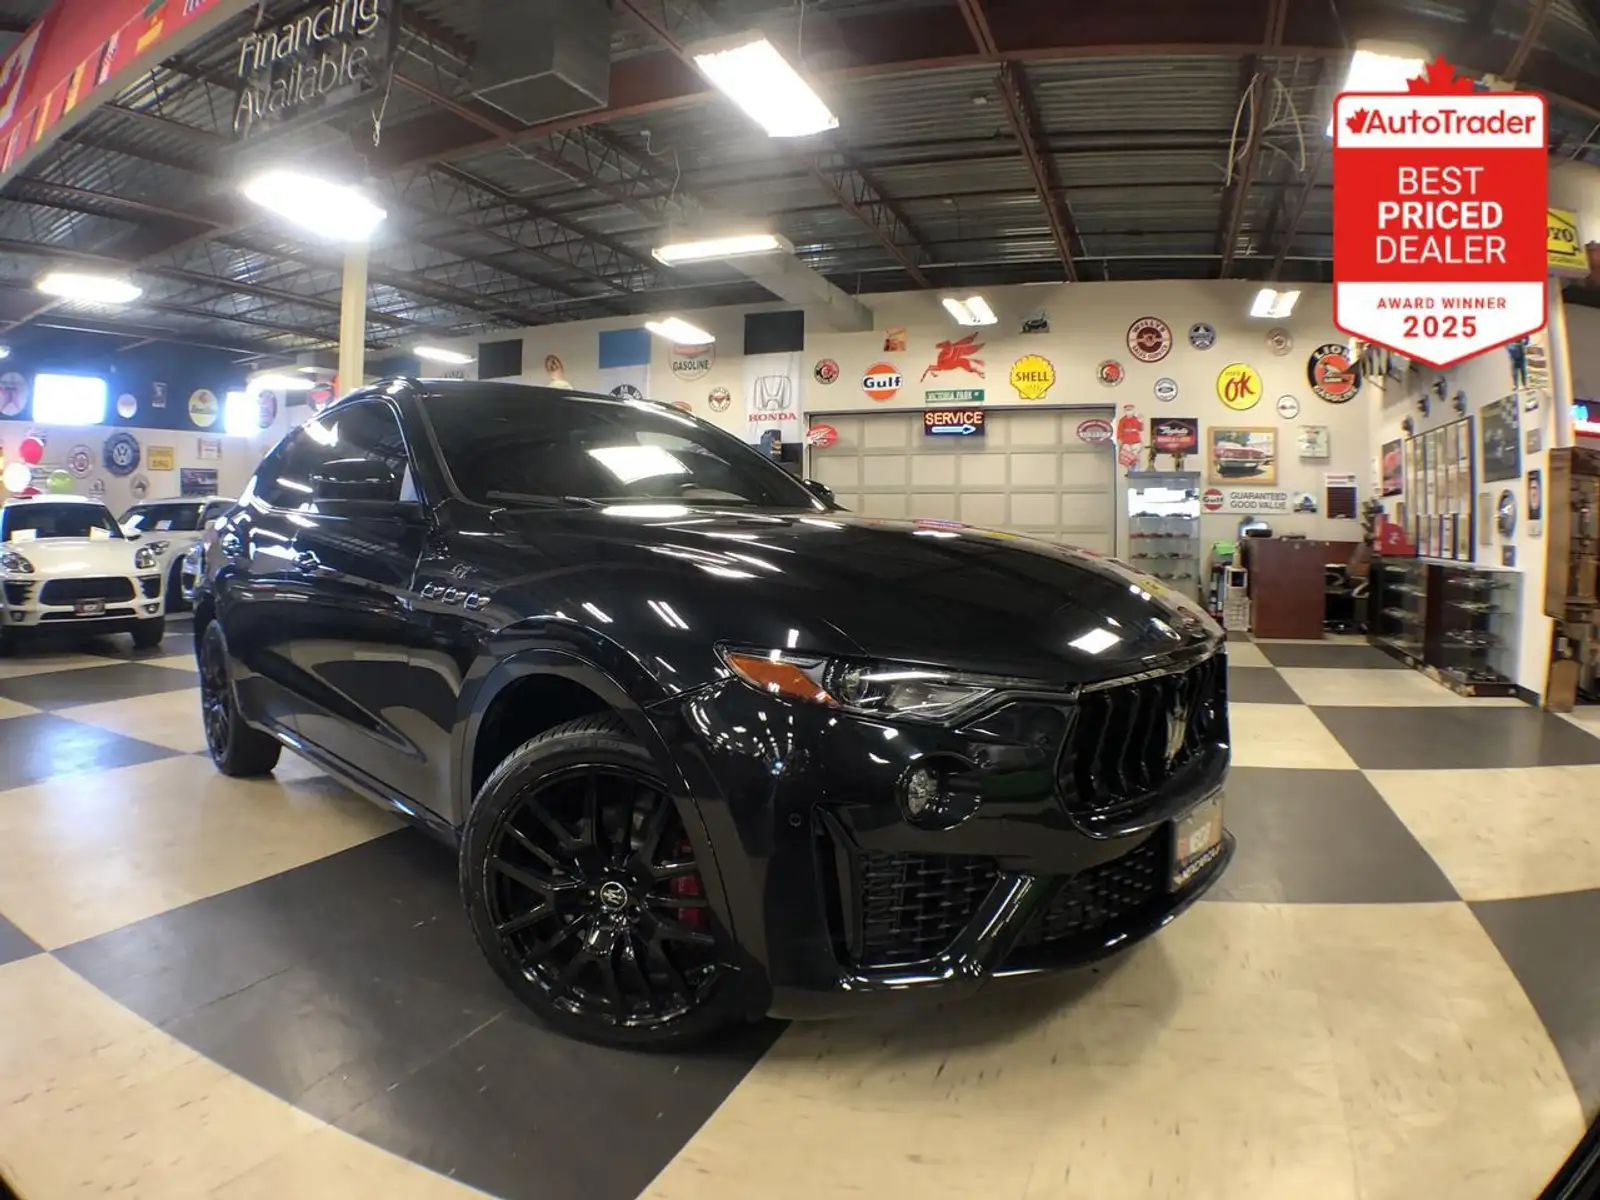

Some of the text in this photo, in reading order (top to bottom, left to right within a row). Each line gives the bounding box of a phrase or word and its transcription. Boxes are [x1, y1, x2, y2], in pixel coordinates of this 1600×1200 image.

[238, 0, 379, 77] Financing
[234, 43, 369, 132] Available
[672, 359, 709, 371] GASOLINE
[863, 376, 901, 388] Gulf
[1015, 371, 1050, 382] SHELL
[1224, 371, 1256, 402] OK
[748, 412, 797, 422] HONDA
[925, 411, 984, 425] SERVICE
[1230, 491, 1288, 501] GUARANTEED
[1230, 501, 1286, 510] GOOD VALUE
